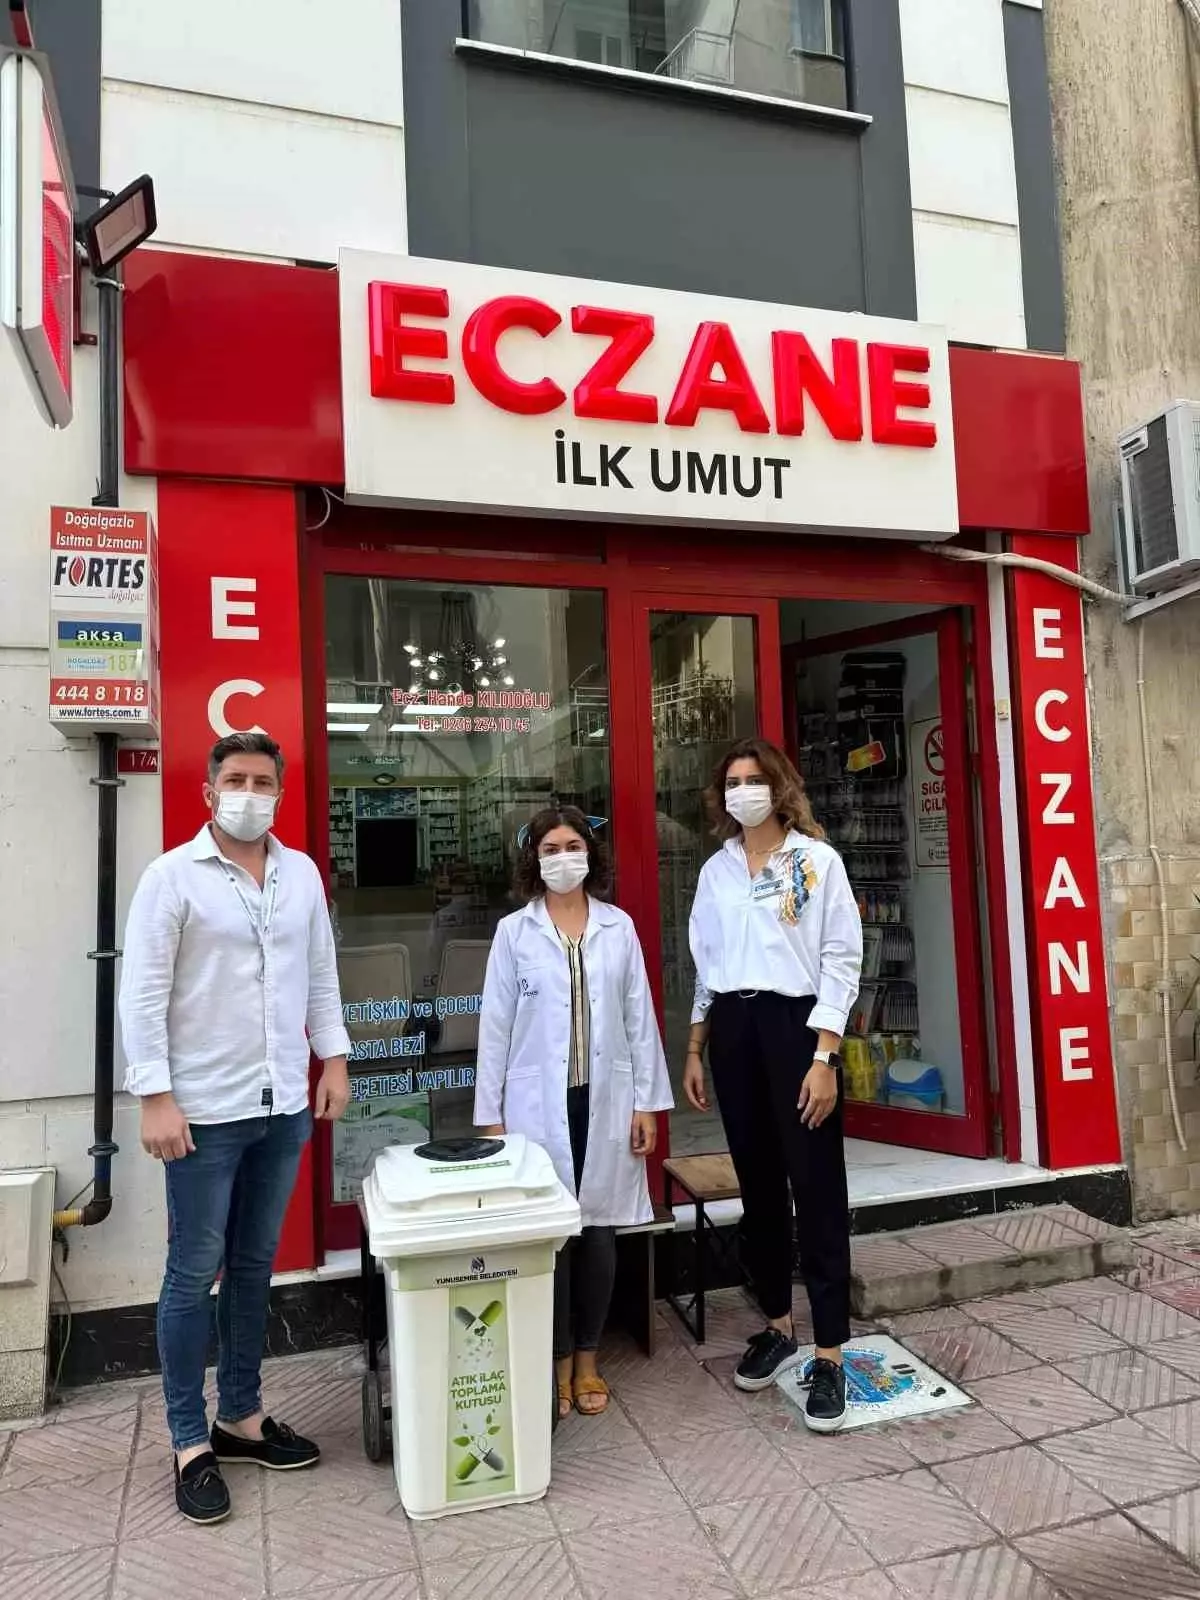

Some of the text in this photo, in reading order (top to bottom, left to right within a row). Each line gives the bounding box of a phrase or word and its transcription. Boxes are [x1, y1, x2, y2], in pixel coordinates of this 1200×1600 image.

[368, 280, 938, 448] ECZANE
[554, 428, 791, 499] İLK UMUT
[65, 511, 135, 529] Doğalgazla
[56, 532, 142, 550] Isıtma Uzmanı
[53, 556, 145, 589] FORTES
[56, 685, 145, 702] 444 8 118
[427, 688, 474, 708] Hande
[60, 706, 142, 719] www.fortes.com.tr
[499, 718, 513, 733] 10
[1032, 607, 1093, 1082] ECZANE
[413, 1002, 433, 1018] ve
[347, 1031, 425, 1061] ASTA BEZİ
[350, 1067, 476, 1101] EÇETESİ YAPILIR
[452, 1374, 477, 1386] ATIK
[450, 1382, 506, 1399] TOPLAMA
[456, 1393, 501, 1410] KUTUSU
